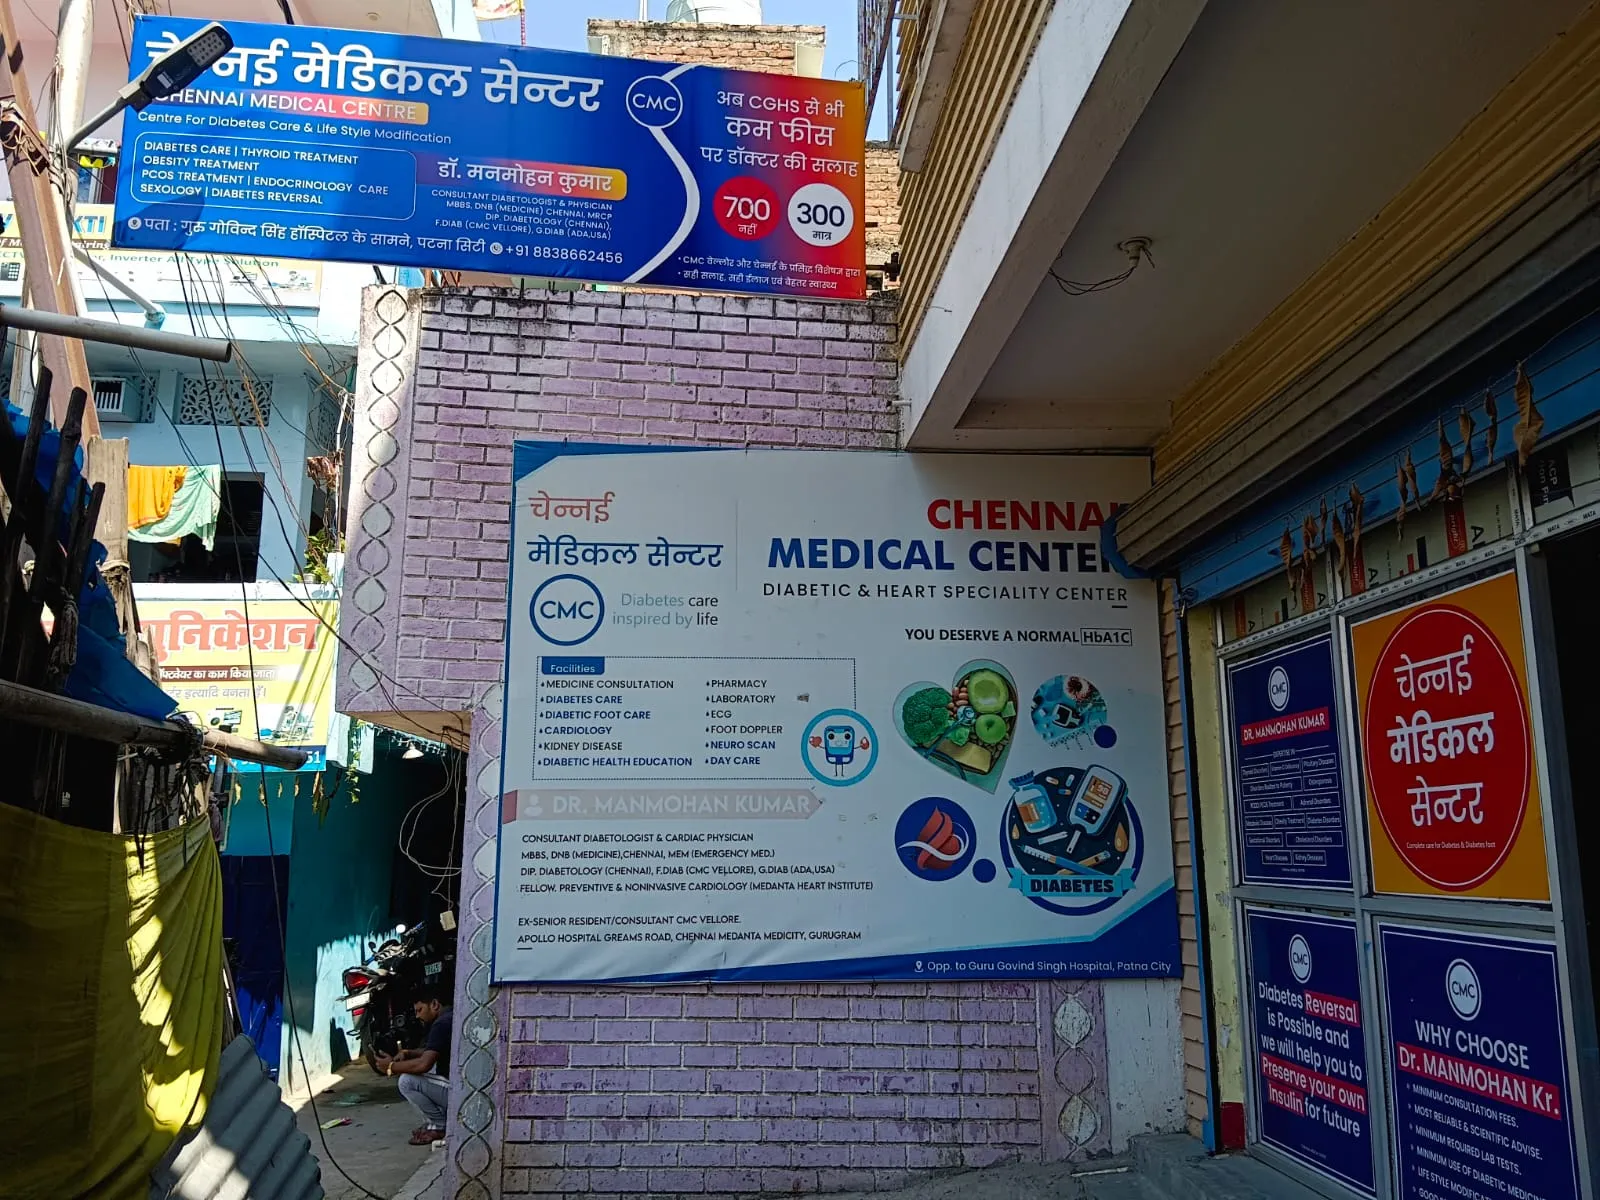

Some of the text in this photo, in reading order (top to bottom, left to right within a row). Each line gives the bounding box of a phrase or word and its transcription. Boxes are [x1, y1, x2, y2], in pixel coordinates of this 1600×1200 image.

[291, 43, 472, 96] मेडिकल
[481, 59, 603, 112] सेन्टर
[250, 95, 336, 113] MEDICAL
[342, 102, 417, 120] CENTRE
[632, 93, 677, 112] CMC
[717, 90, 844, 117] अब CGHS से भी
[138, 112, 451, 144] Centre For Diabetes Care Life Style Modification
[725, 116, 835, 146] कम फीस
[144, 141, 358, 164] DIABETES CARE THYROID TREATMENT
[700, 146, 858, 177] पर डॉक्टर की सलाह
[143, 155, 259, 171] OBESITY TREATMENT
[142, 170, 388, 195] PCOS TREATMENT ENDOCRINOLOGY CARE
[437, 158, 613, 193] डॉ. मनमोहन कुमार
[432, 190, 612, 210] CONSULTANT DIABETOLOGIST PHYSICIAN
[496, 203, 544, 215] (MEDICINE)
[723, 196, 770, 220] 700
[797, 203, 845, 227] 300
[290, 223, 485, 253] हॉस्पिटल पटना सिटी
[812, 230, 832, 241] मात्र
[505, 243, 623, 264] +91 8838662456
[683, 256, 704, 265] CMC
[528, 490, 615, 523] चेन्नई
[527, 535, 723, 567] मेडिकल सेन्टर
[768, 537, 955, 570] MEDICAL
[621, 593, 718, 607] Diabetes care
[763, 583, 1128, 601] DIABETIC & HEART SPECIALITY CENTER
[540, 600, 594, 620] CMC
[613, 613, 718, 629] inspired by life
[906, 628, 935, 641] YOU
[940, 629, 999, 642] DESERVE
[1004, 630, 1014, 642] A
[1017, 631, 1080, 643] NORMAL
[551, 663, 595, 674] Facilities
[1394, 634, 1474, 701] चेन्नई
[547, 681, 674, 689] MEDICINE CONSULTATION
[712, 680, 767, 688] PHARMACY
[1272, 682, 1287, 696] CMC
[546, 695, 623, 704] DIABETES CARE
[711, 695, 775, 703] LABORATORY
[545, 711, 620, 719] DIABETIC FOOT
[711, 710, 732, 718] ECG
[545, 726, 612, 735] CARDIOLOGY
[711, 726, 783, 734] FOOT DOPPLER
[1244, 713, 1325, 741] DR. MANMOHAN KUMAR
[1387, 710, 1494, 765] मेडिकल
[553, 795, 810, 815] DR. MANMOHAN KUMAR
[1407, 776, 1483, 826] सेन्टर
[522, 833, 753, 843] CONSULTANT DIABETOLOGIST CARDIAC PHYSICIAN
[1030, 879, 1114, 893] DIABETES
[518, 916, 697, 926] EX-SENIOR RESIDENT/CONSULTANT CMC
[518, 931, 861, 943] APOLLO HOSPITAL GREAMS ROAD, CHENNAI MEDANTA MEDICITY, GURUGRAM
[928, 961, 1171, 974] Opp. to Guru Govind Singh Hospital, Patna City
[1293, 952, 1308, 966] CMC
[1452, 981, 1475, 999] CMC
[1259, 982, 1357, 1024] Diabetes Reversal
[1267, 1008, 1349, 1049] is Possible and
[1415, 1020, 1529, 1070] WHY CHOOSE
[1261, 1034, 1362, 1080] we will help you to
[1263, 1057, 1365, 1111] Preserve your own
[1400, 1046, 1559, 1115] Dr. MANMOHAN Kr.
[1269, 1084, 1360, 1137] Insulin for future
[1413, 1084, 1518, 1128] MINIMUM CONSULTATION FEES.
[1415, 1104, 1543, 1160] MOST RELIABLE SCIENTIFIC ADVISE.
